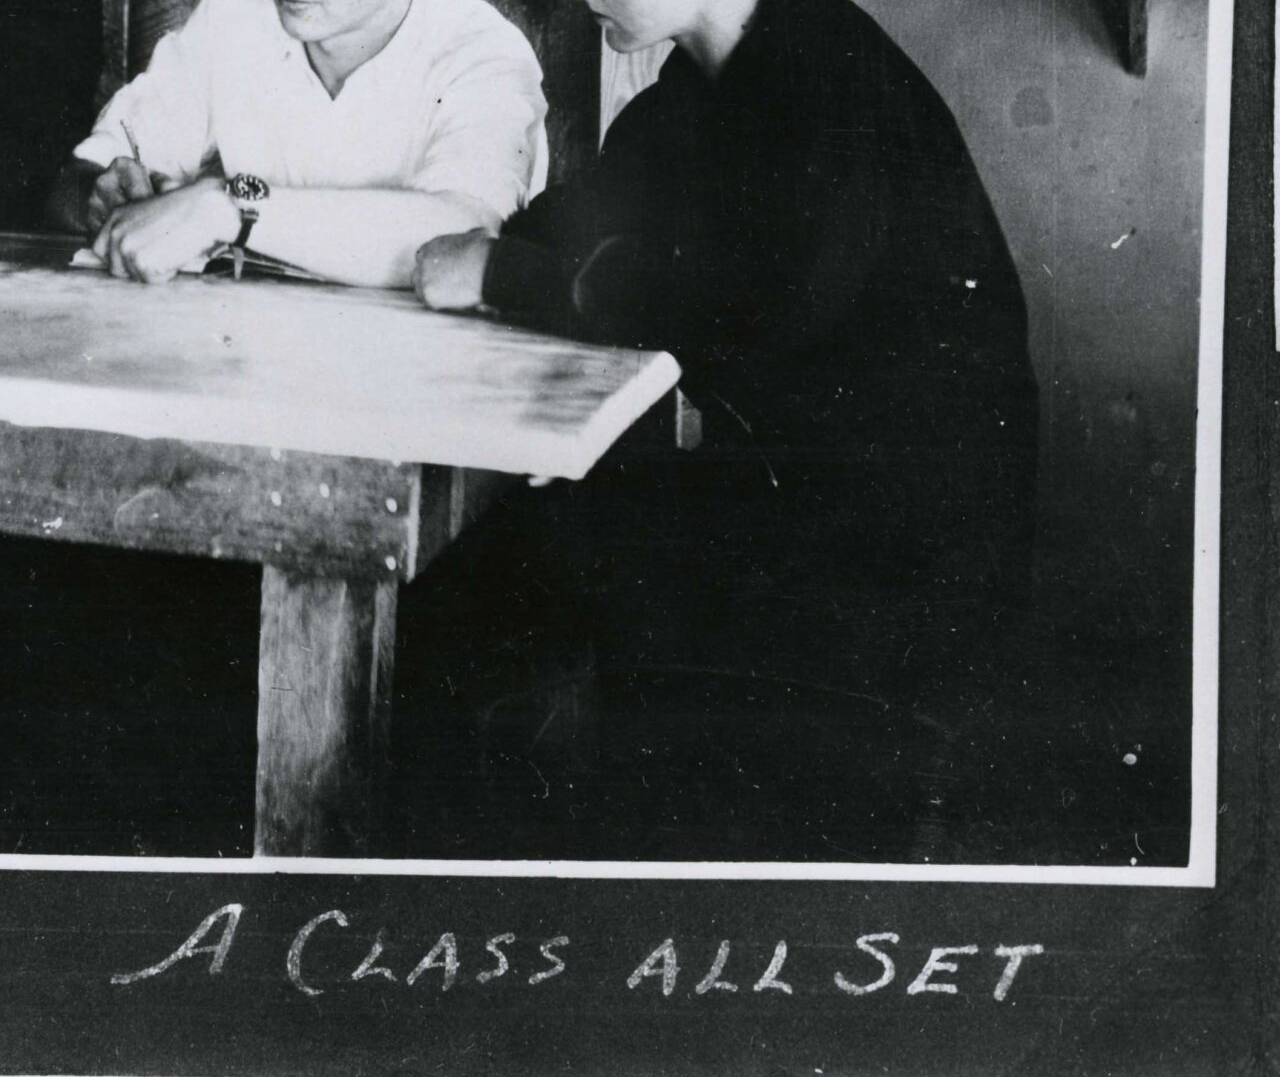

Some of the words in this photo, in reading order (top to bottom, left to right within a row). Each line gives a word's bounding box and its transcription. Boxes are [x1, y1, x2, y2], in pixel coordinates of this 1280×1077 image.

[110, 902, 244, 982] A
[287, 908, 570, 994] CLASS
[628, 937, 793, 997] ALL
[834, 931, 1046, 1001] SET
